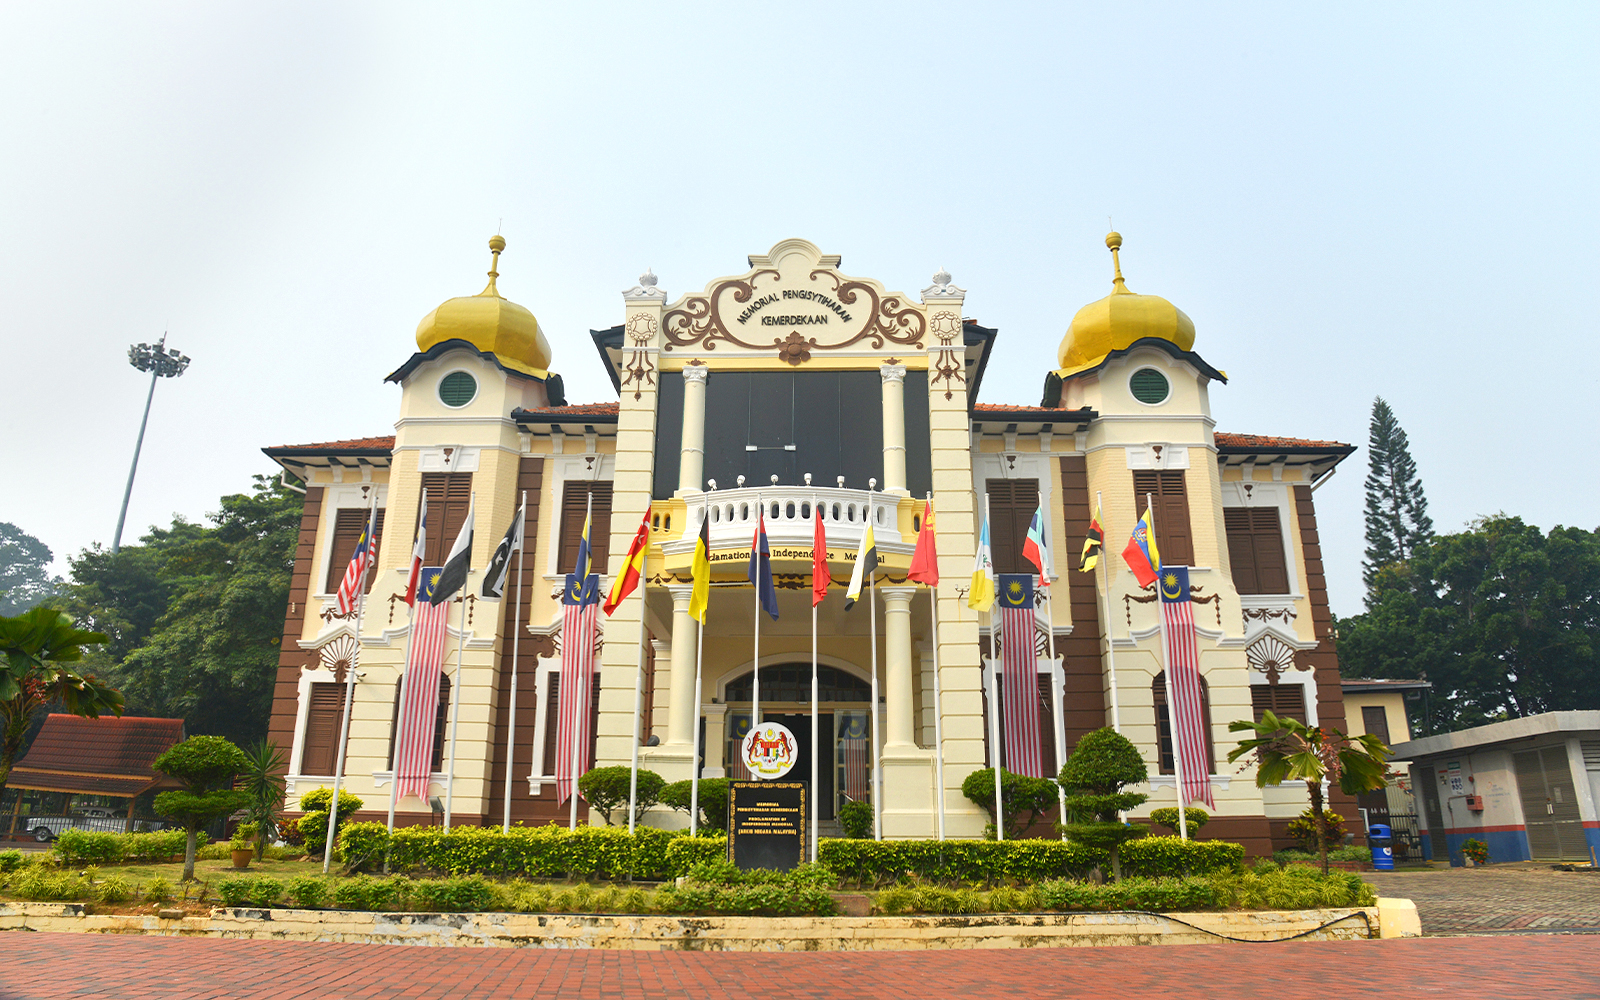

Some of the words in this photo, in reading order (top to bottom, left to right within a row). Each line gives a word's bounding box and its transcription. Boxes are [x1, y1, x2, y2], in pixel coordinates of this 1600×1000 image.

[737, 293, 780, 325] MEMORIAL
[782, 290, 853, 323] PENGISYTIHARAN
[761, 314, 828, 326] KEMERDEKAAN
[709, 551, 751, 561] clamation
[773, 549, 834, 560] Independce
